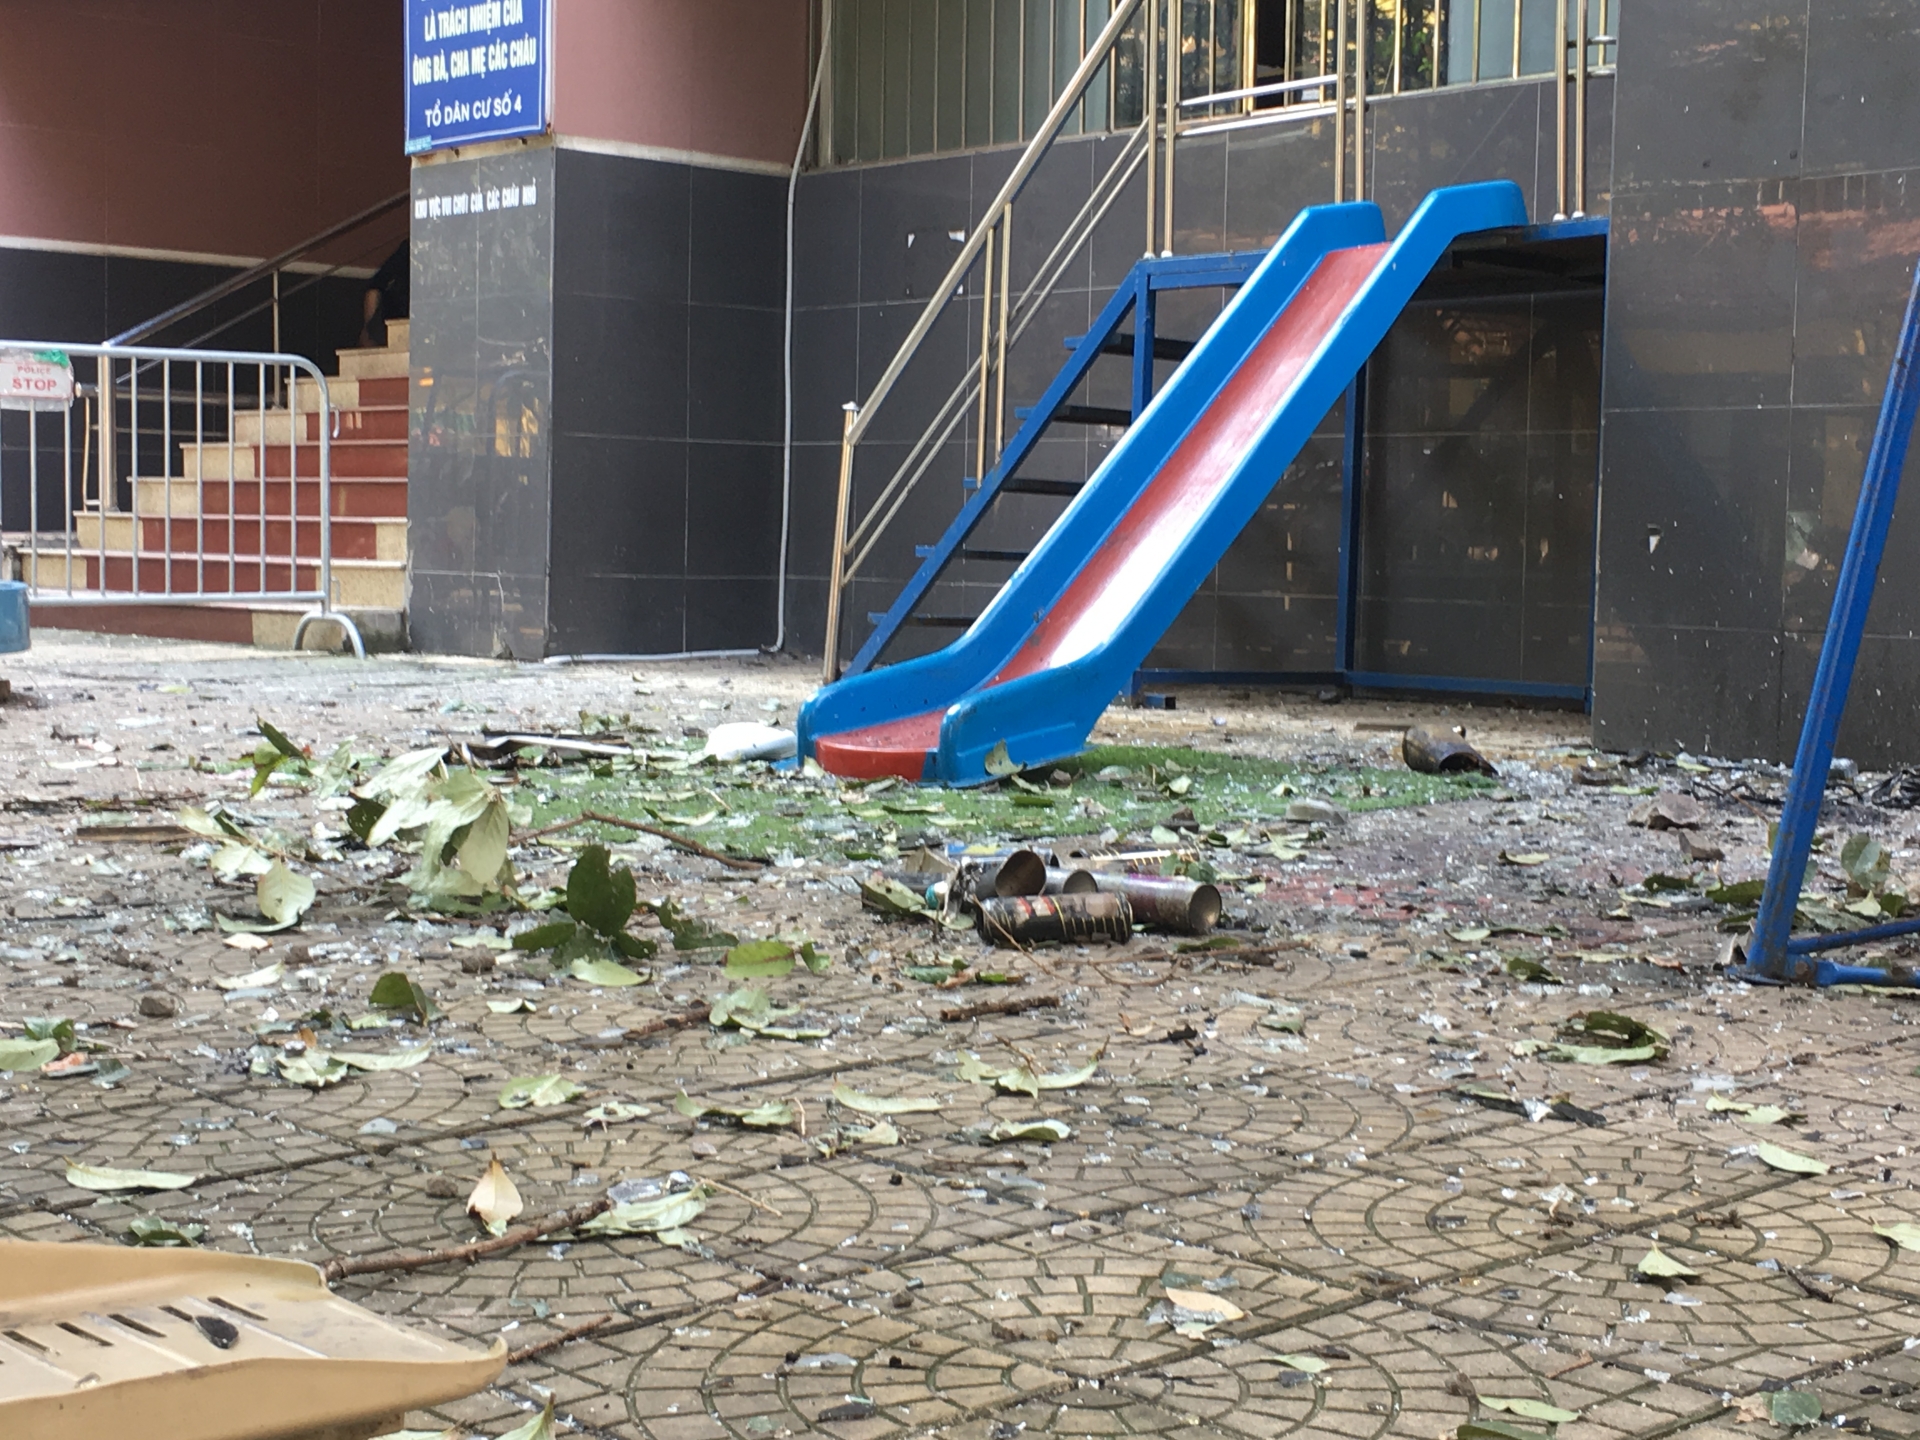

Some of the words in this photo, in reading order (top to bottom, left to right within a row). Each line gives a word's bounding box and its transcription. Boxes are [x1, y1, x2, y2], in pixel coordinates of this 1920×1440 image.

[424, 8, 436, 42] LÀ
[438, 5, 467, 39] TRÁCH
[412, 53, 431, 86] ÔNG
[433, 49, 449, 83] BÀ,
[450, 49, 469, 79] CHA
[471, 45, 486, 79] MẸ
[488, 38, 508, 72] CÁC
[509, 32, 536, 68] CHÁU
[425, 98, 442, 128] TỔ
[444, 99, 470, 125] DÂN
[472, 96, 491, 121] CƯ
[493, 88, 513, 117] SỐ
[514, 93, 522, 114] 4
[414, 198, 428, 220] KHU
[12, 376, 57, 391] STOP
[17, 365, 51, 375] POLICE
